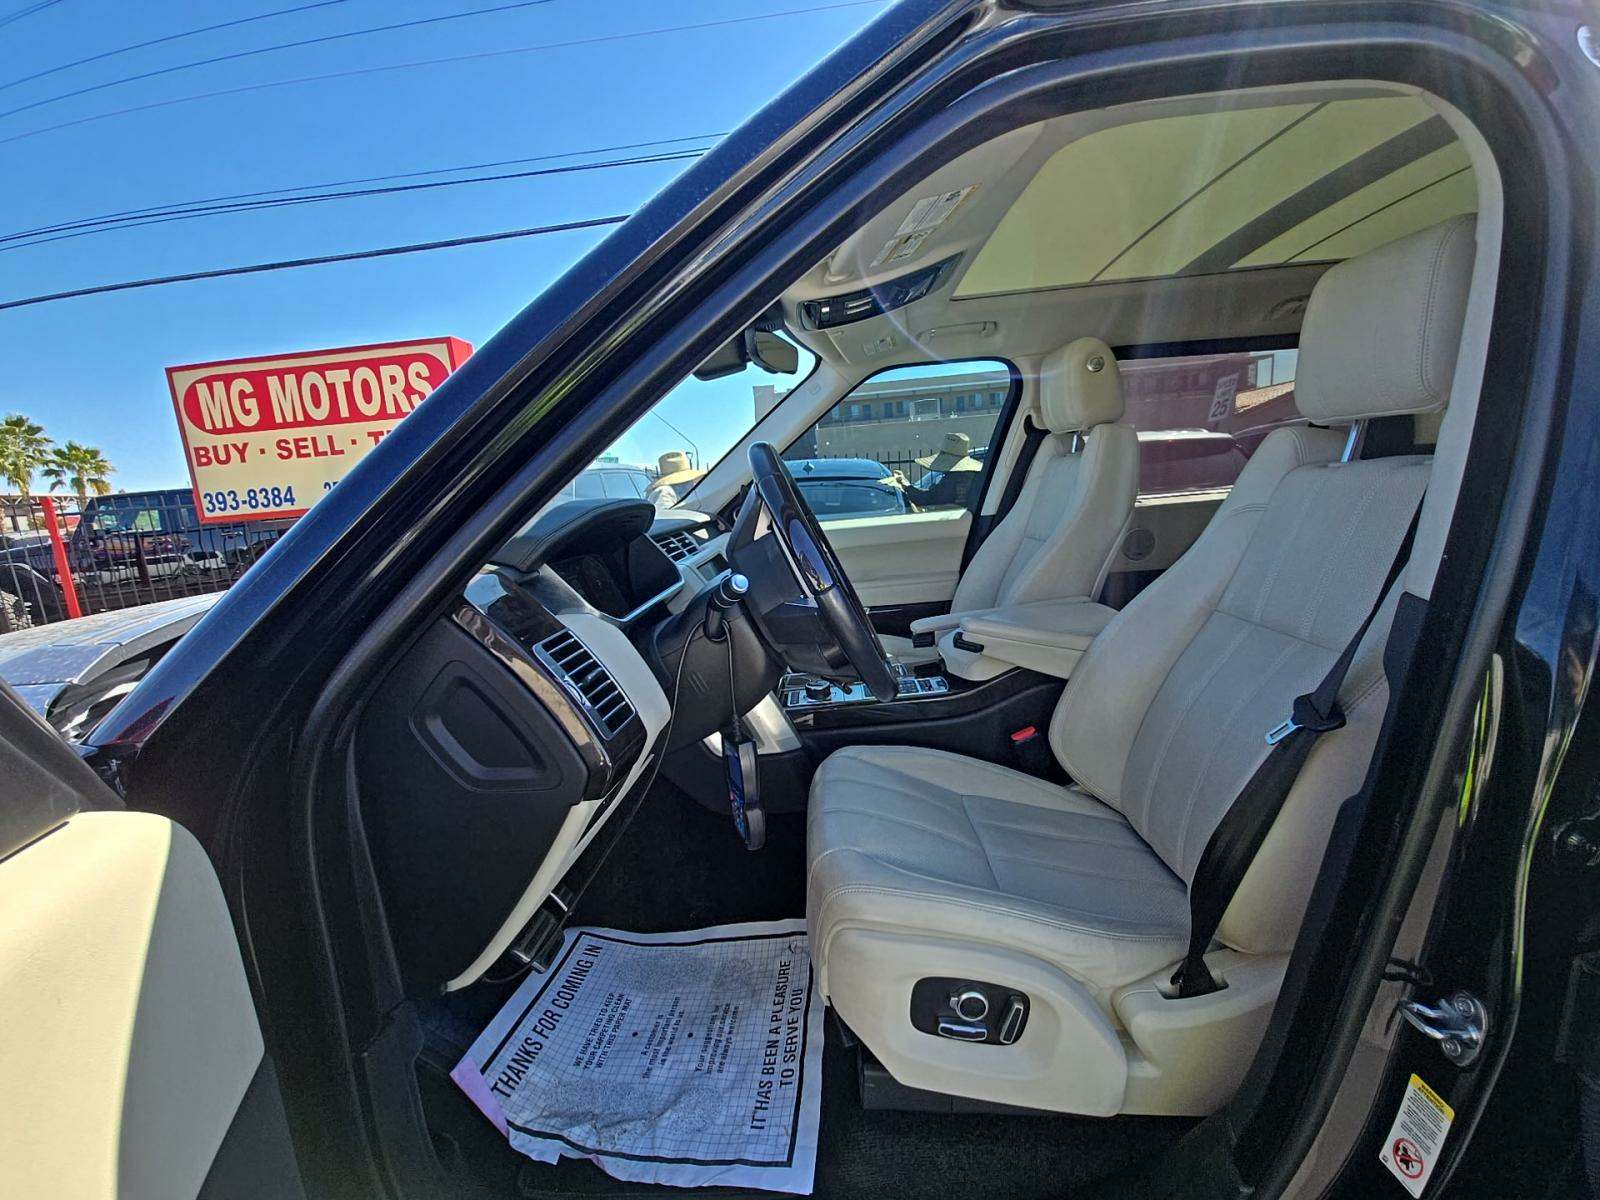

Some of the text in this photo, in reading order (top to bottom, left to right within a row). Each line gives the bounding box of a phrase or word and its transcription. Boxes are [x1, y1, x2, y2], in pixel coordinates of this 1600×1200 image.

[196, 361, 433, 430] MG MOTORS
[1211, 399, 1229, 417] 25
[194, 442, 249, 467] BUY
[275, 435, 345, 460] SELL
[203, 486, 296, 514] 393-8384
[491, 944, 603, 1098] THANKS FOR COMING IN
[573, 992, 614, 1066] WE HAVE TRIED TO KEEP
[583, 993, 625, 1070] YOUR CARPETING CLEAN
[596, 998, 632, 1068] WITH THIS PAPER MAT
[750, 960, 791, 1130] IT HAS BEEN A PLEASURE
[779, 989, 803, 1088] TO SERVE YOU
[694, 1055, 705, 1072] Your
